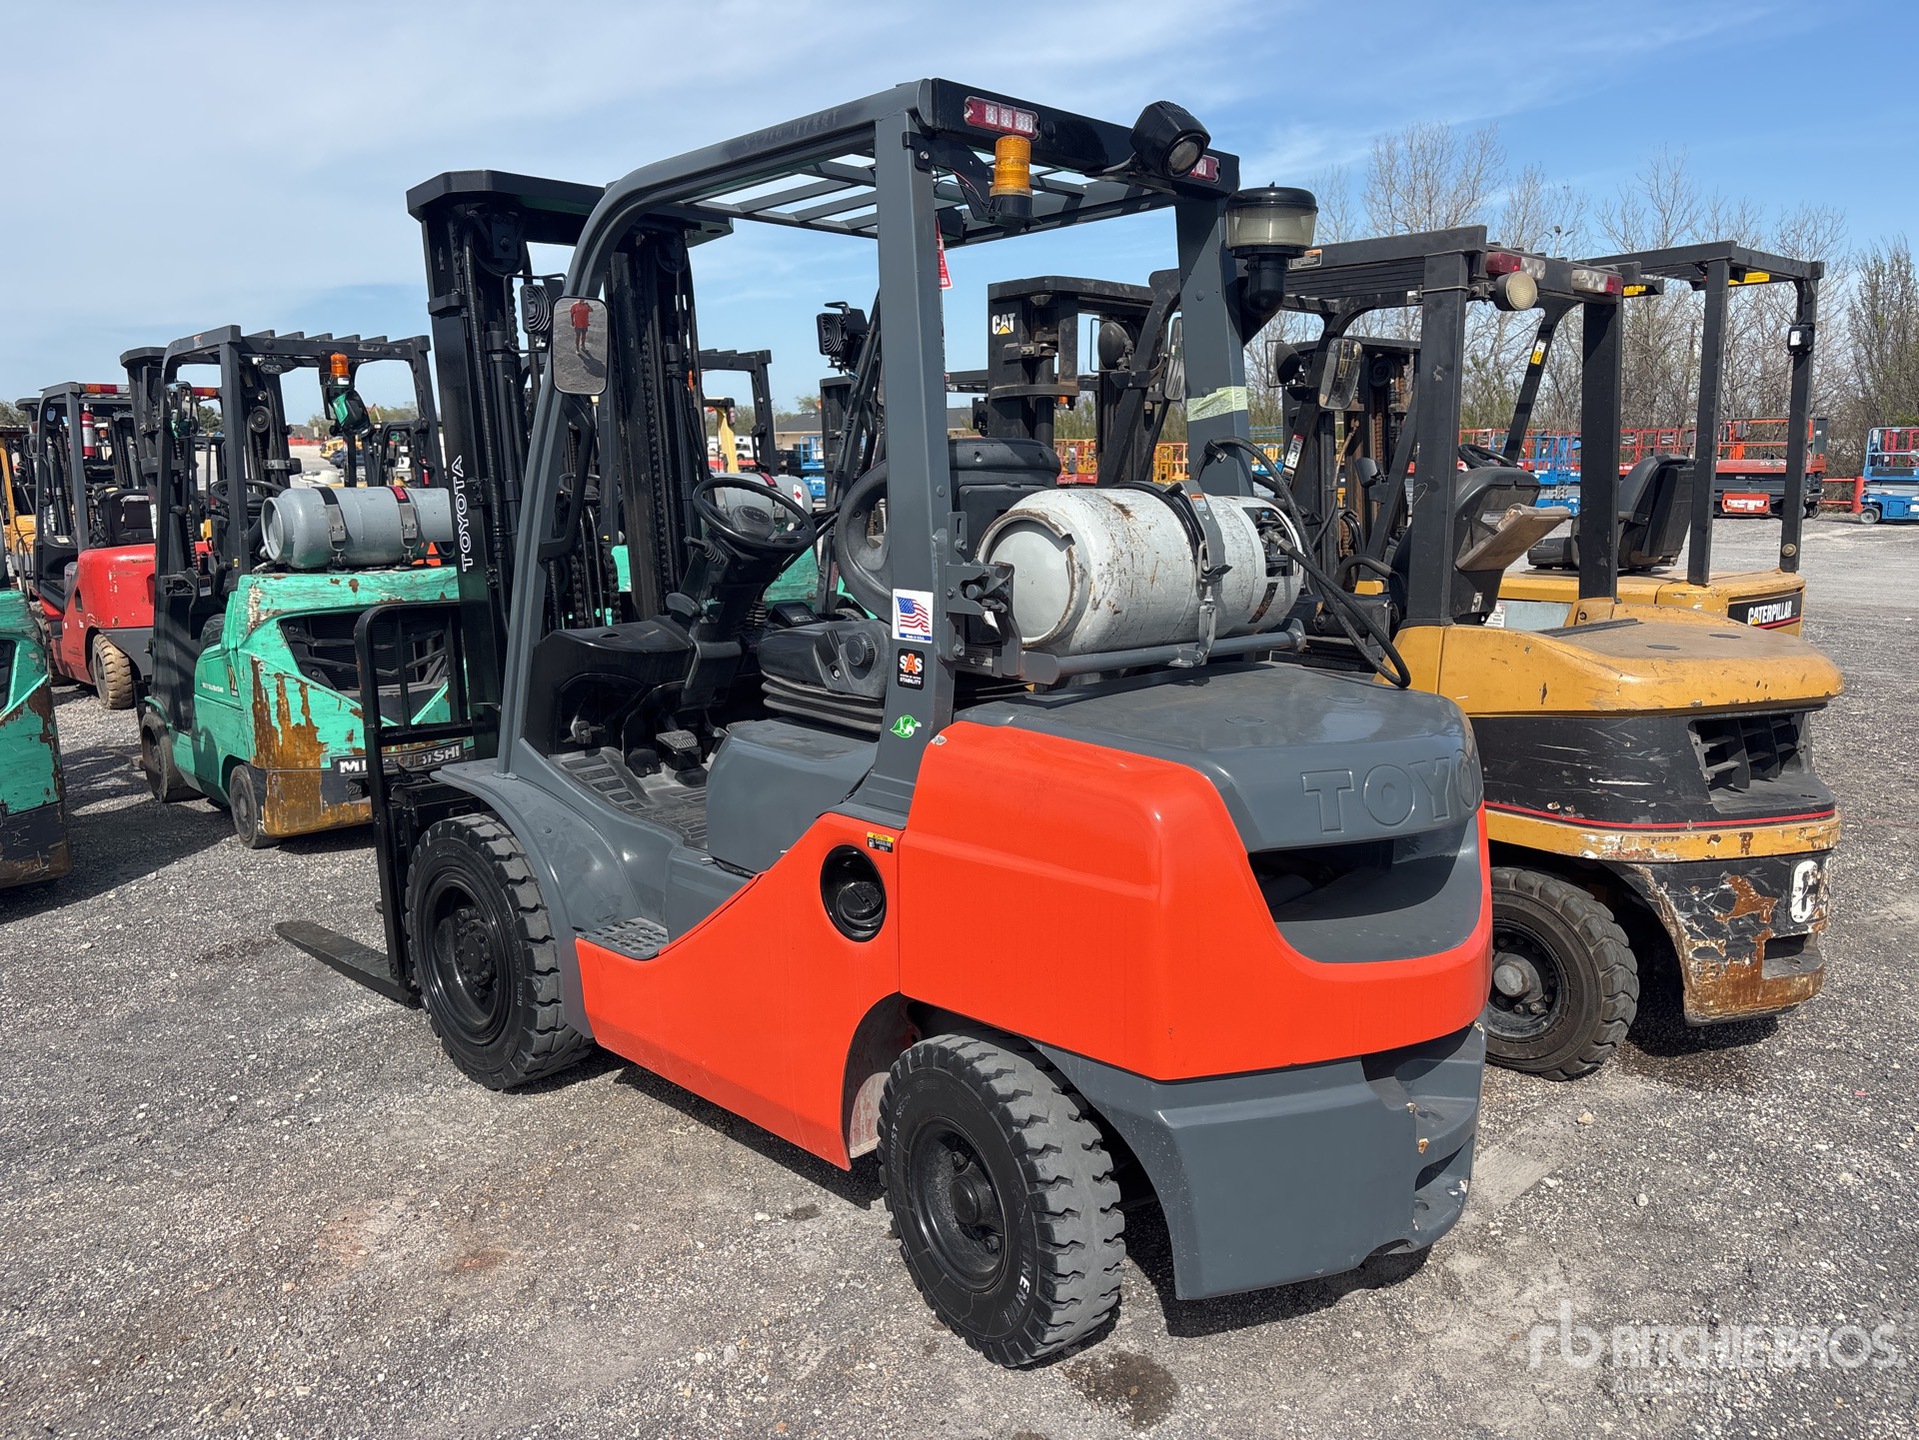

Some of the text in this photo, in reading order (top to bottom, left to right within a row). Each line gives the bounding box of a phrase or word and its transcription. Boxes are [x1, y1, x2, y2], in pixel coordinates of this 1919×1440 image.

[992, 313, 1016, 335] CAT
[452, 455, 474, 572] TOYOTA
[1747, 600, 1793, 626] CATERPILLAR
[899, 653, 923, 674] SAS
